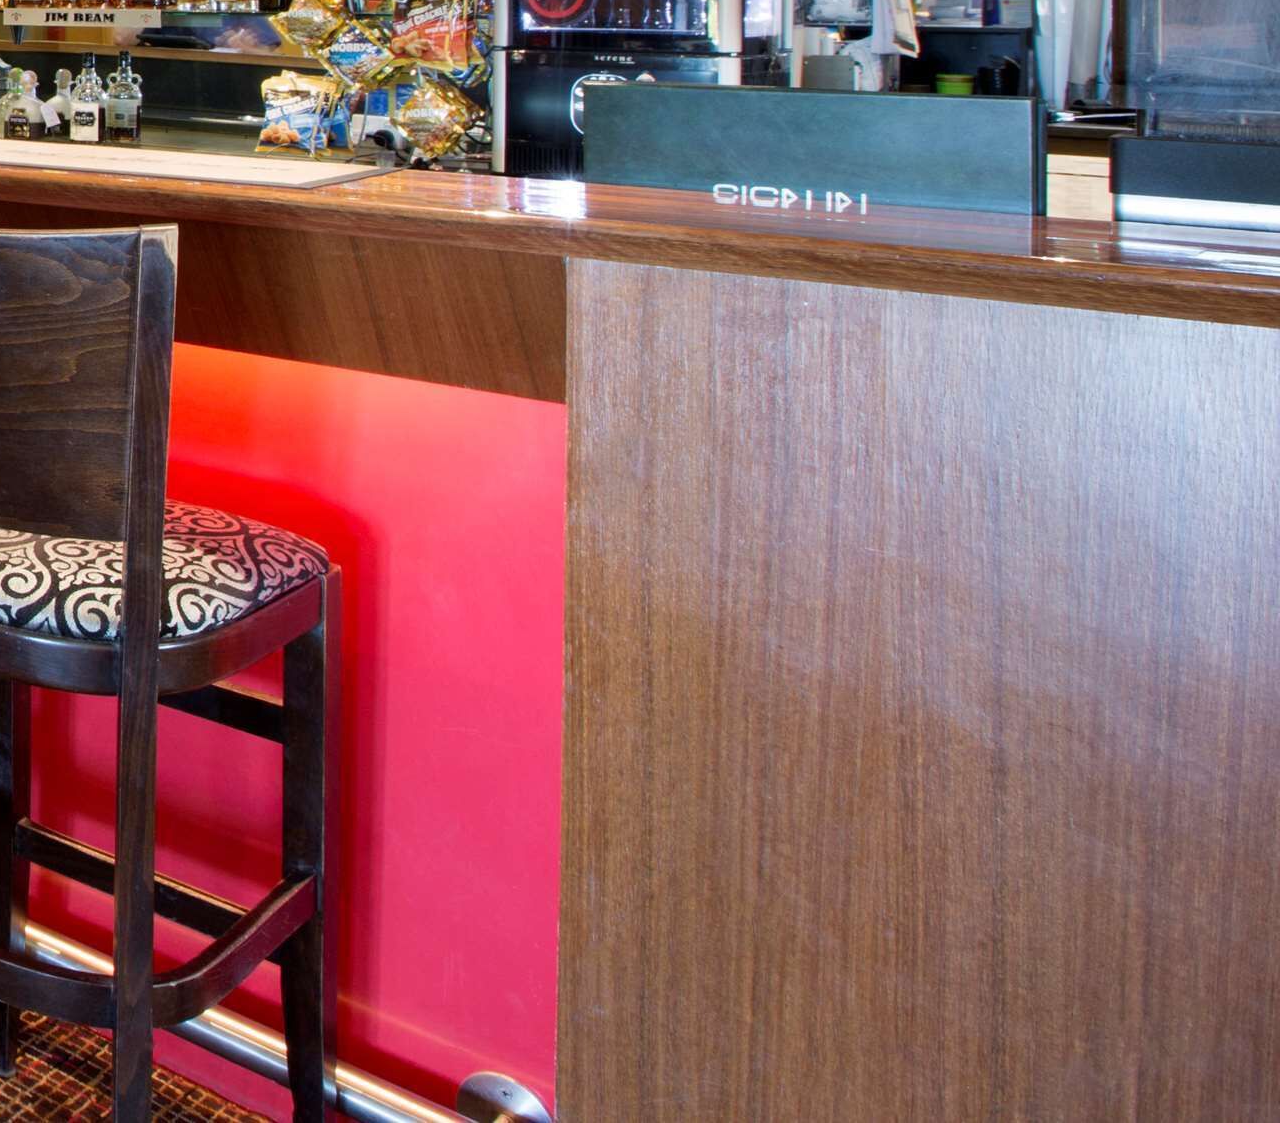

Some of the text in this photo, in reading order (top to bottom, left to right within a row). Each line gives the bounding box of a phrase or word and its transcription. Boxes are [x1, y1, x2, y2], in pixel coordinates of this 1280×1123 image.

[45, 12, 115, 23] JIM BEAM
[594, 54, 633, 62] serene
